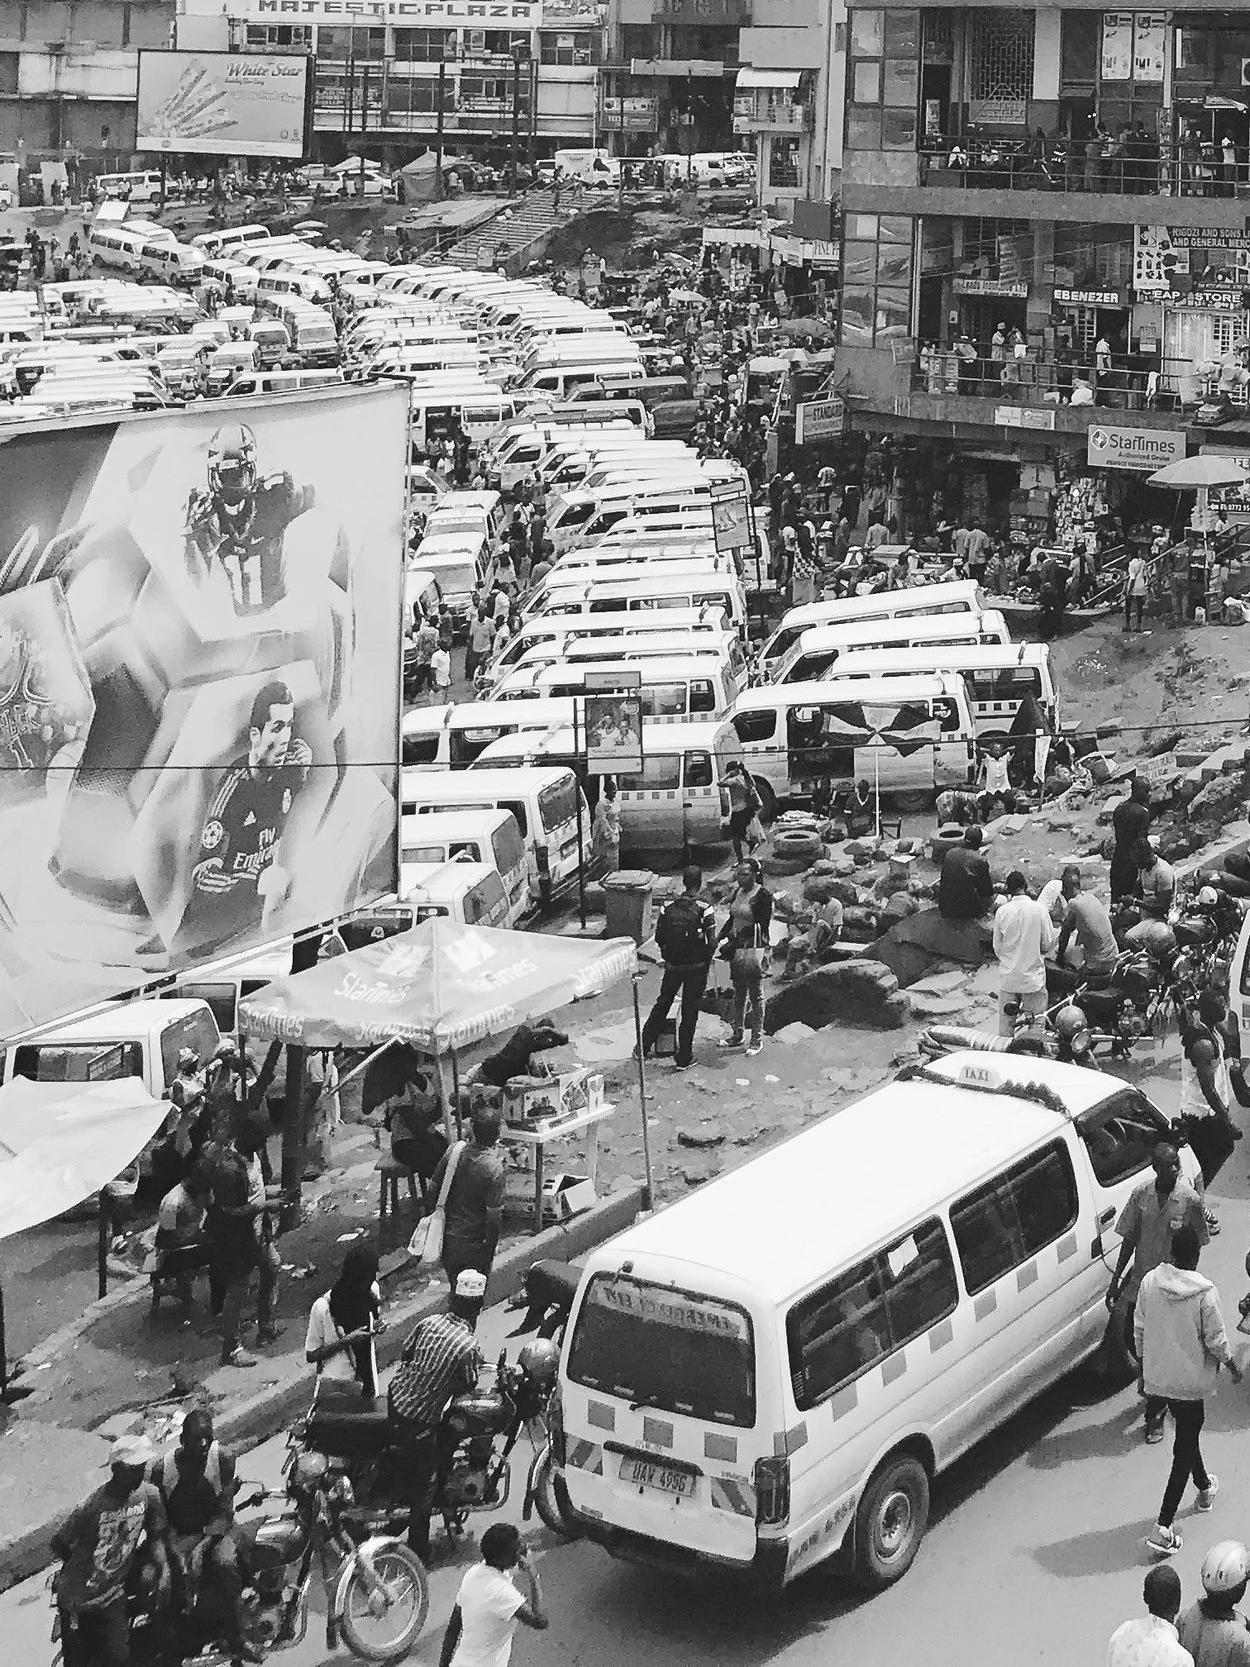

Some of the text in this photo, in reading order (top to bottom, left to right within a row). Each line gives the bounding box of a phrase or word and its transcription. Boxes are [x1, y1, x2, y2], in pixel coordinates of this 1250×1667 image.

[425, 3, 531, 18] PLAZA
[227, 62, 303, 77] White Star
[1201, 228, 1218, 237] AND
[1220, 229, 1242, 238] SONS
[1172, 237, 1189, 247] AND
[1190, 238, 1227, 248] GENERAL
[1053, 289, 1119, 303] EBENEZER
[1194, 292, 1241, 303] STORE
[1109, 433, 1176, 453] StarTimes
[232, 844, 275, 870] Emira
[963, 1066, 989, 1082] TAXI
